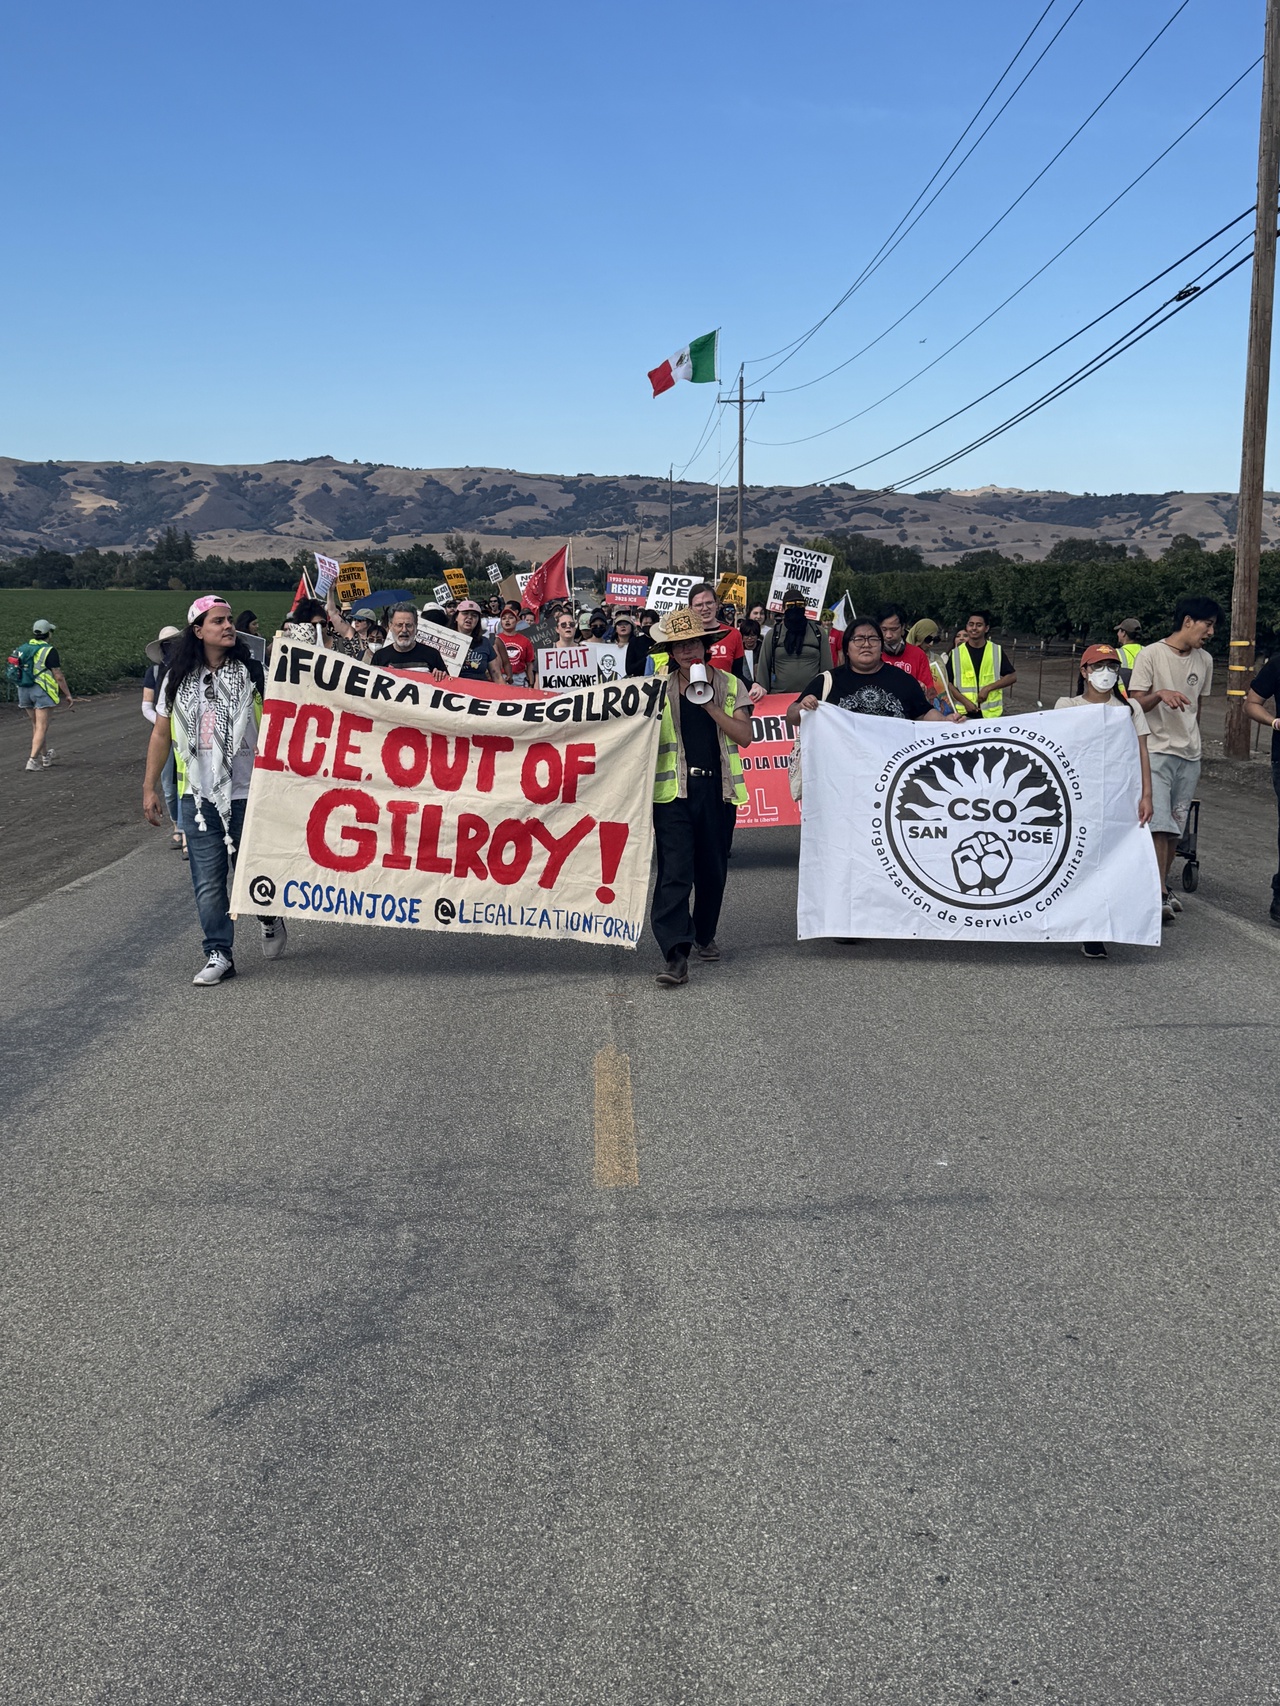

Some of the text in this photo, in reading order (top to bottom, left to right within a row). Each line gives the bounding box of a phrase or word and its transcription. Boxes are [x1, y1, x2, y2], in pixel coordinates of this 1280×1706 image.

[783, 548, 827, 564] DOWN
[790, 557, 818, 568] WITH
[339, 572, 361, 582] CENTER
[783, 562, 823, 584] TRUMP
[661, 576, 693, 587] NO
[341, 588, 366, 599] GILROY
[611, 583, 643, 595] RESIST
[655, 586, 690, 598] ICE
[799, 585, 811, 595] THE
[654, 600, 673, 610] STOP
[536, 622, 548, 631] NO
[438, 639, 460, 651] HISTORY
[545, 648, 589, 670] FIGHT
[274, 645, 420, 706] ¡FUERA
[430, 690, 491, 717] ICE
[542, 674, 597, 689] IGNORANCE
[254, 699, 596, 805] I.C.E. OUT OF
[755, 756, 771, 770] LA
[874, 725, 1083, 801] Community Service Organization
[947, 798, 1017, 823] CSO
[908, 826, 1053, 845] SAN JOSÉ
[306, 788, 630, 905] GILROY!
[871, 817, 1087, 928] Organización de Servicio Comunitario
